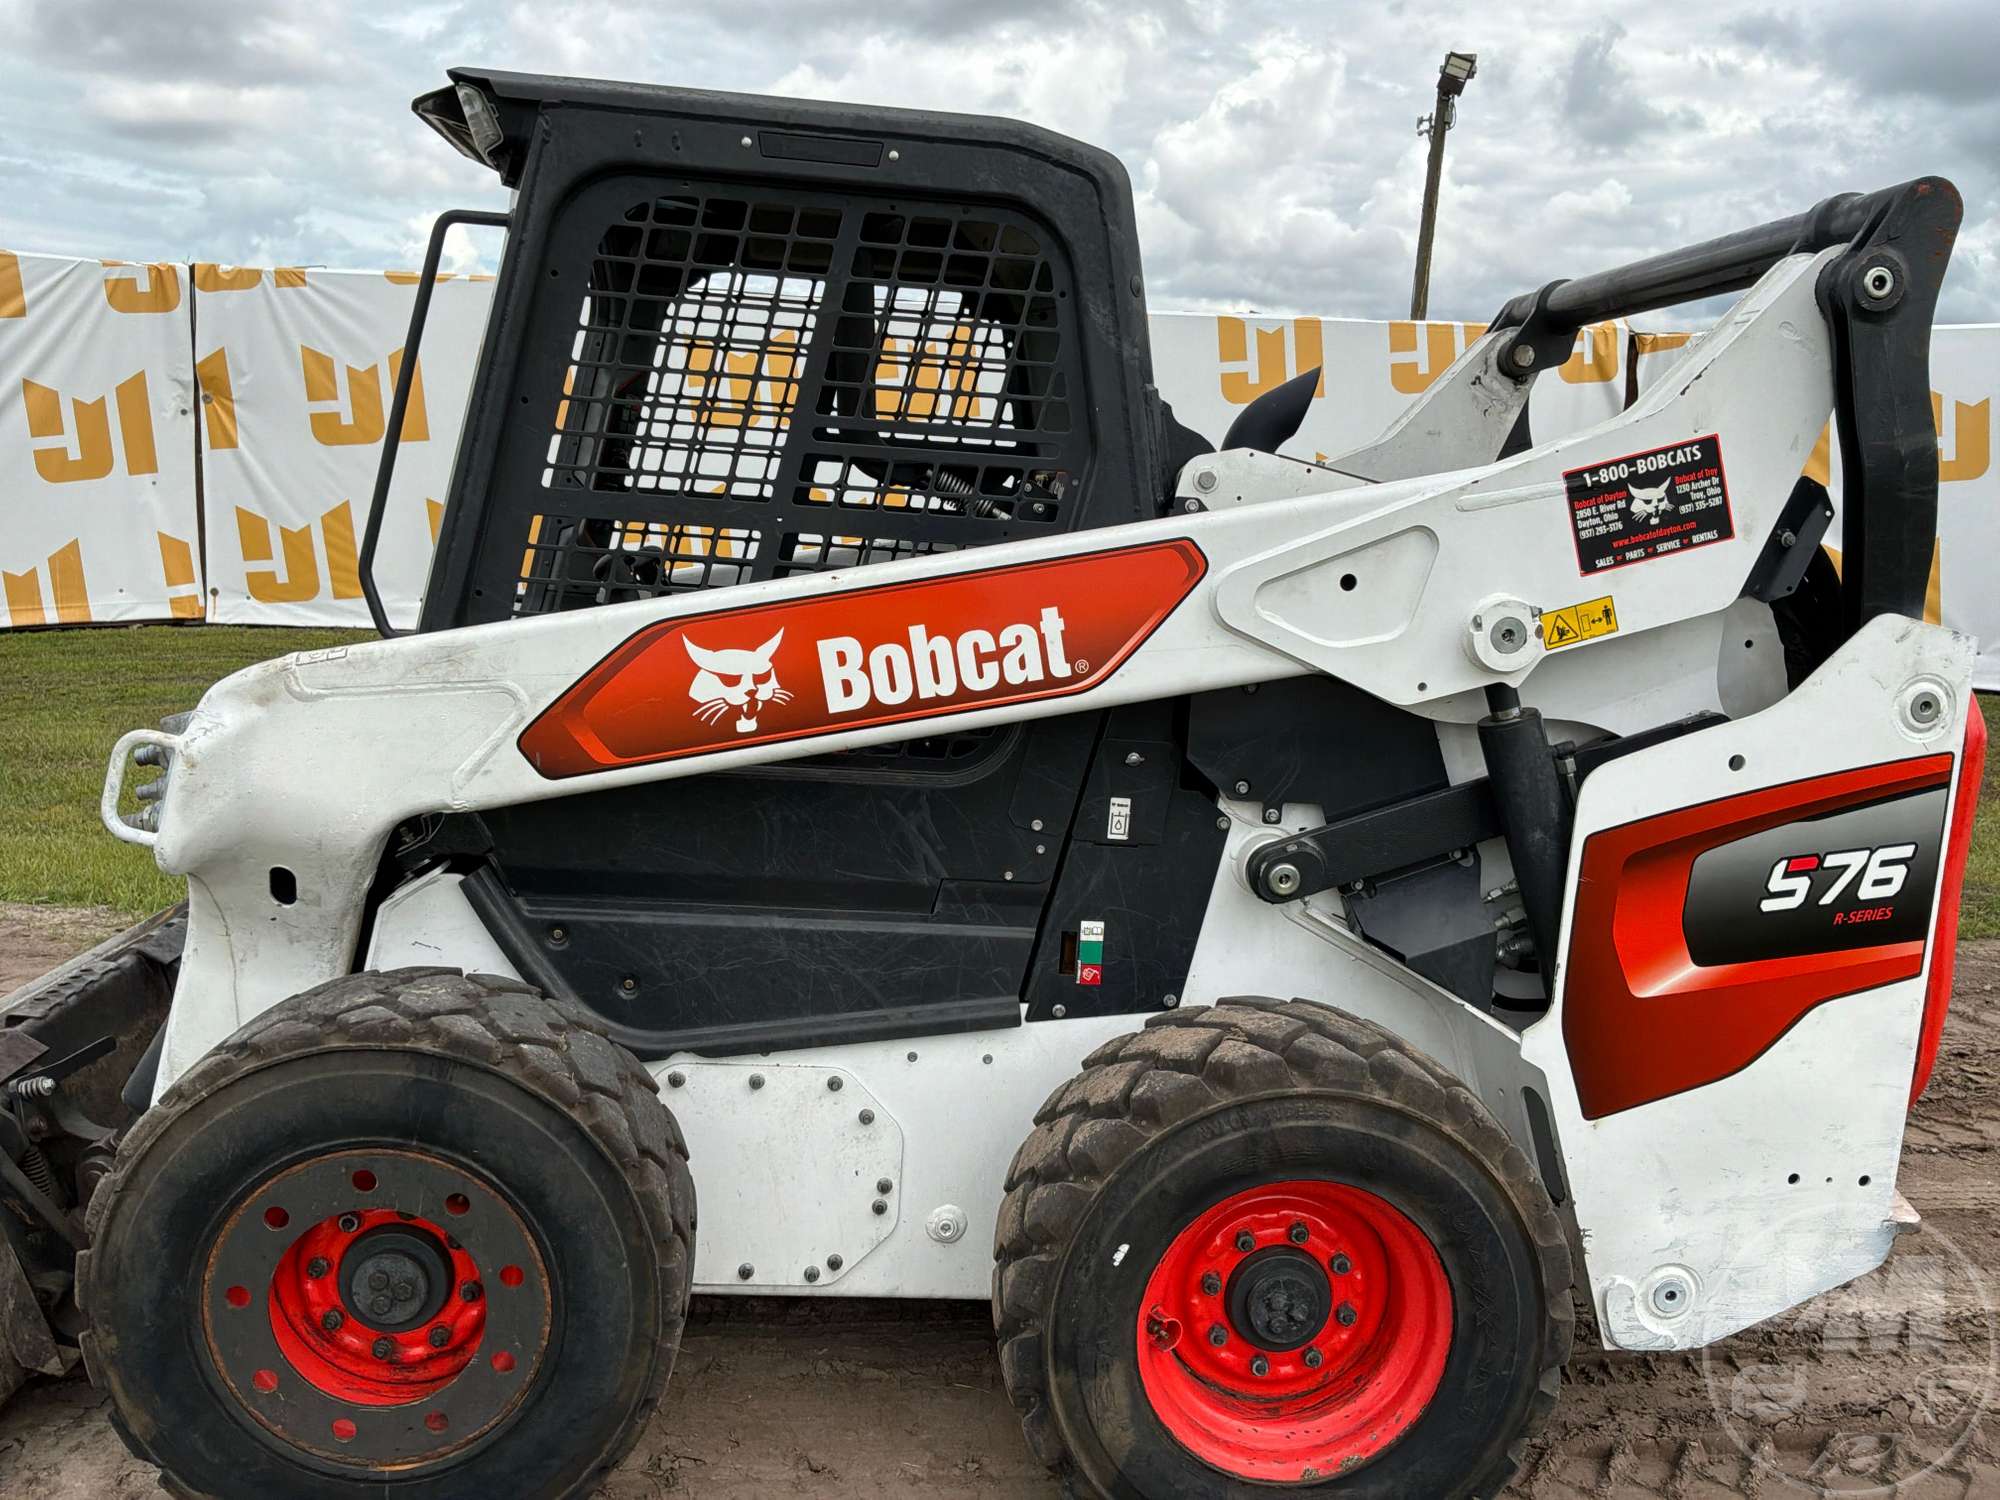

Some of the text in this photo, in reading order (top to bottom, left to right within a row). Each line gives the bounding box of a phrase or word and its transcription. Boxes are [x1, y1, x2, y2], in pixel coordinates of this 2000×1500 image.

[1583, 444, 1702, 488] 1-800-BOBCATS
[1674, 467, 1718, 485] Bobcat of Troy
[1691, 478, 1711, 491] Archer
[1711, 476, 1720, 485] Dr
[1706, 486, 1722, 497] Ohio
[1574, 490, 1628, 510] Bobcat of Dayton
[1599, 502, 1617, 514] River
[1617, 499, 1627, 509] Rd
[1577, 511, 1619, 530] Dayton, Ohio
[1612, 521, 1697, 549] www.bobcatofdayton.com
[1595, 529, 1719, 569] SALES PARTS SERVICE RENTALS
[1760, 844, 1916, 913] S76
[1833, 906, 1894, 926] R-SERIES
